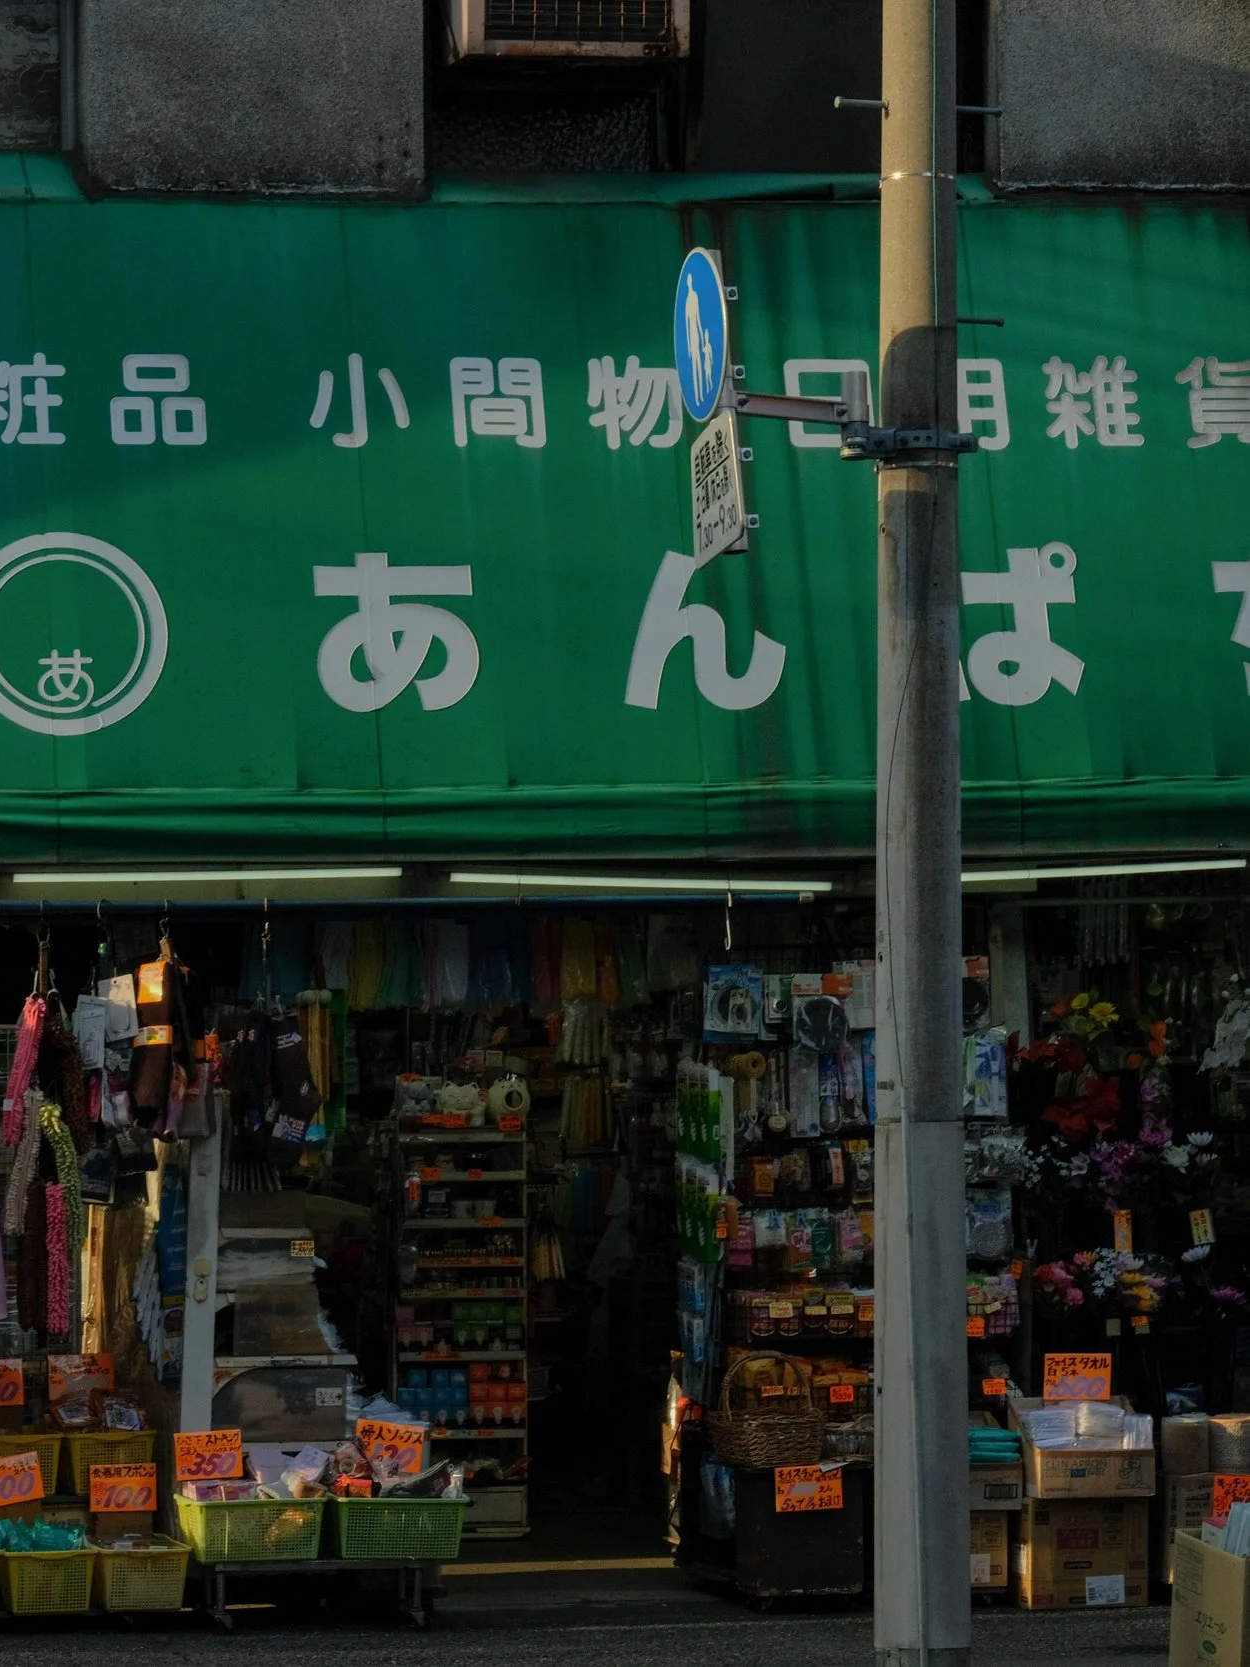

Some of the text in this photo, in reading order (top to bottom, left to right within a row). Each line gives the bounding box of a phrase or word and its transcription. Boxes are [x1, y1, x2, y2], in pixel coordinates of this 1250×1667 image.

[308, 352, 682, 450] 小間物
[312, 541, 1250, 713] あんぱ
